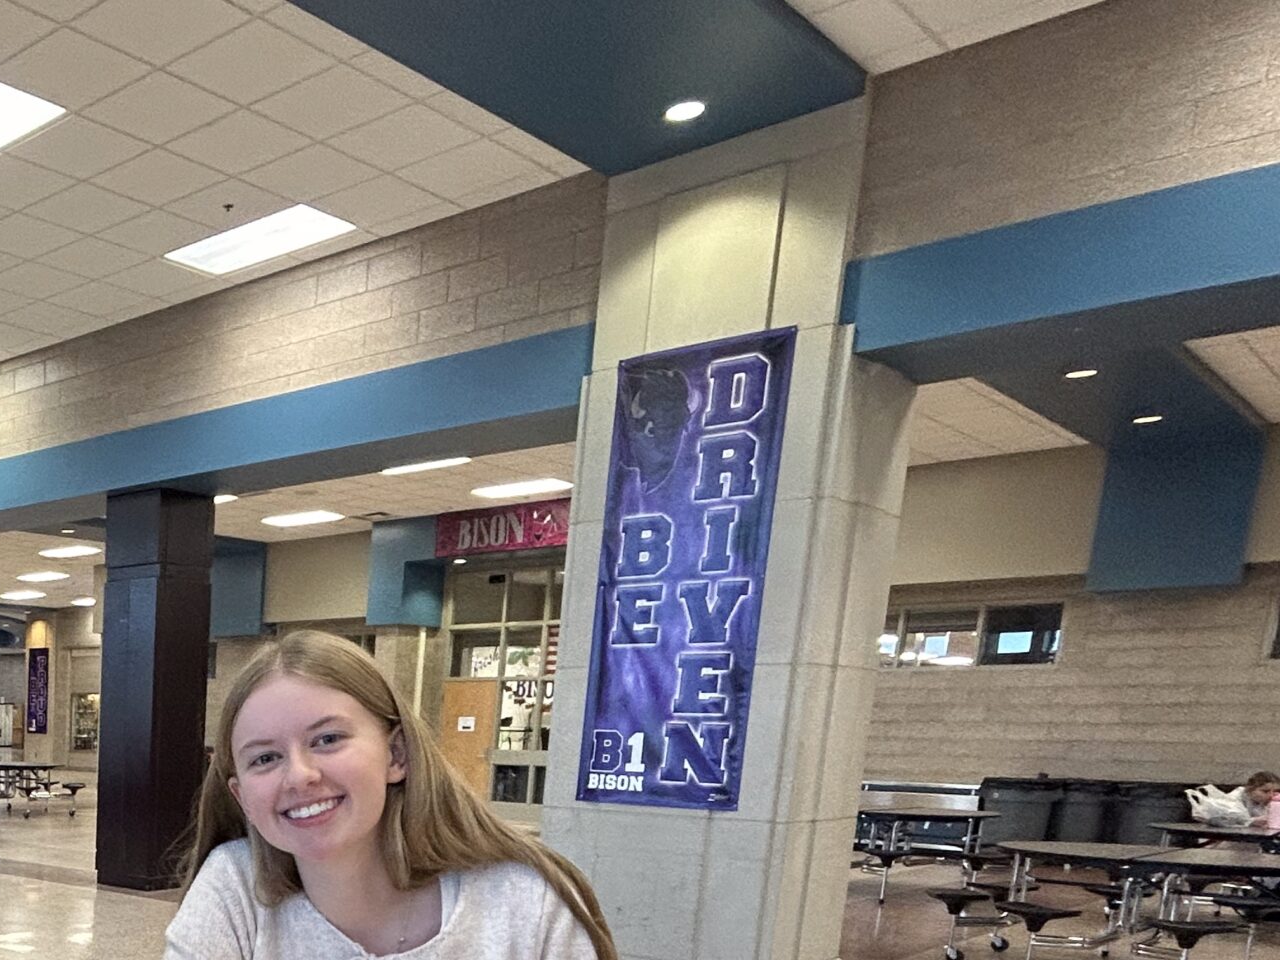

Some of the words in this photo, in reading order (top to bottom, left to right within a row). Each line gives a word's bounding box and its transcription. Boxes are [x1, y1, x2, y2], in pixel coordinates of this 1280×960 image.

[457, 511, 524, 550] BISON
[658, 352, 771, 785] DRIVEN
[610, 513, 673, 647] BE
[587, 773, 644, 792] BISON
